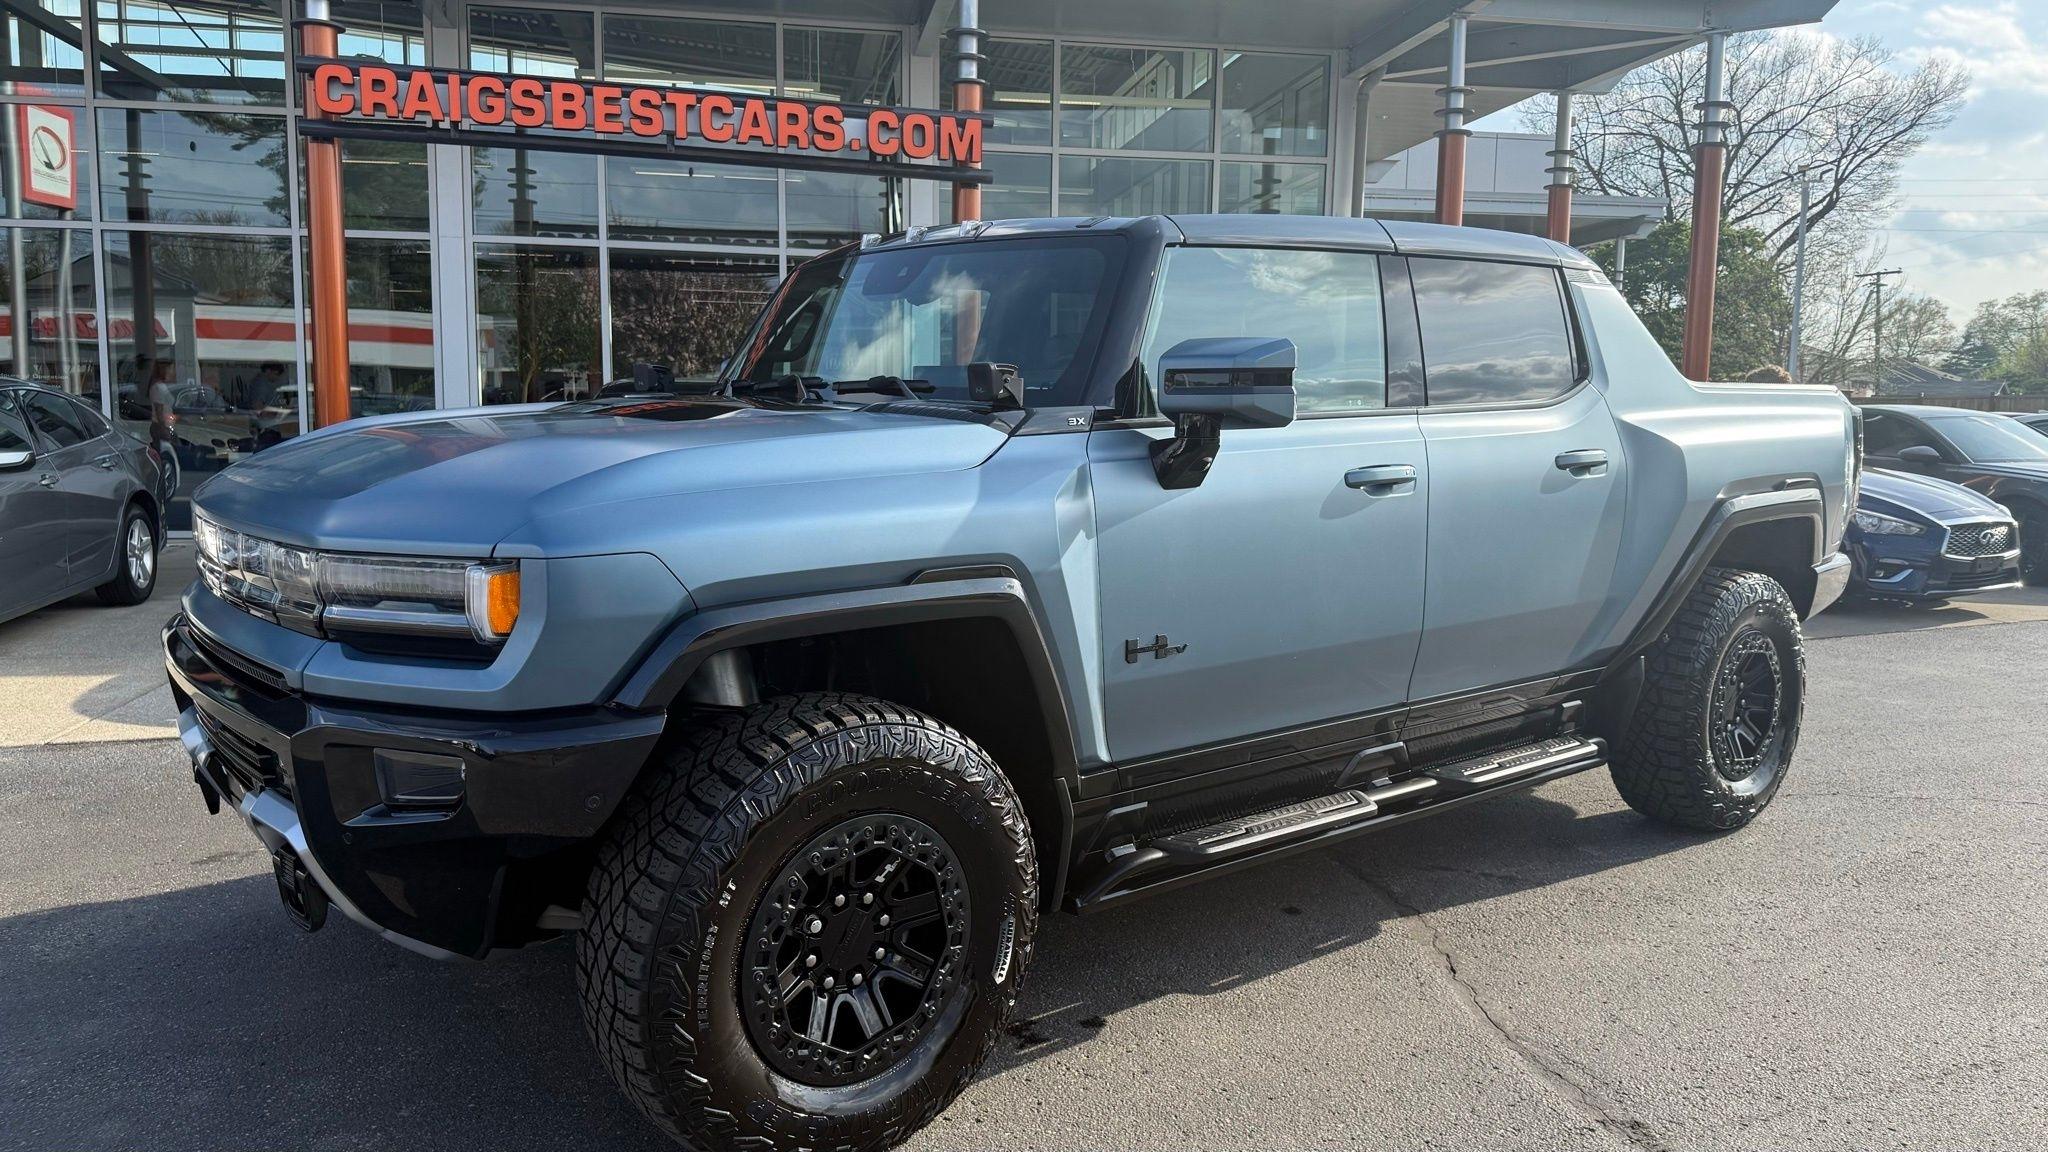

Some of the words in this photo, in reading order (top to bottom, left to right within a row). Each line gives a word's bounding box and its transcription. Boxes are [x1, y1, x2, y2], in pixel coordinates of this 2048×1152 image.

[314, 63, 982, 163] CRAIGSBESTCARS.COM
[1067, 416, 1086, 427] 3X
[696, 919, 720, 1035] TERRITORY
[997, 919, 1014, 979] DURAWALL
